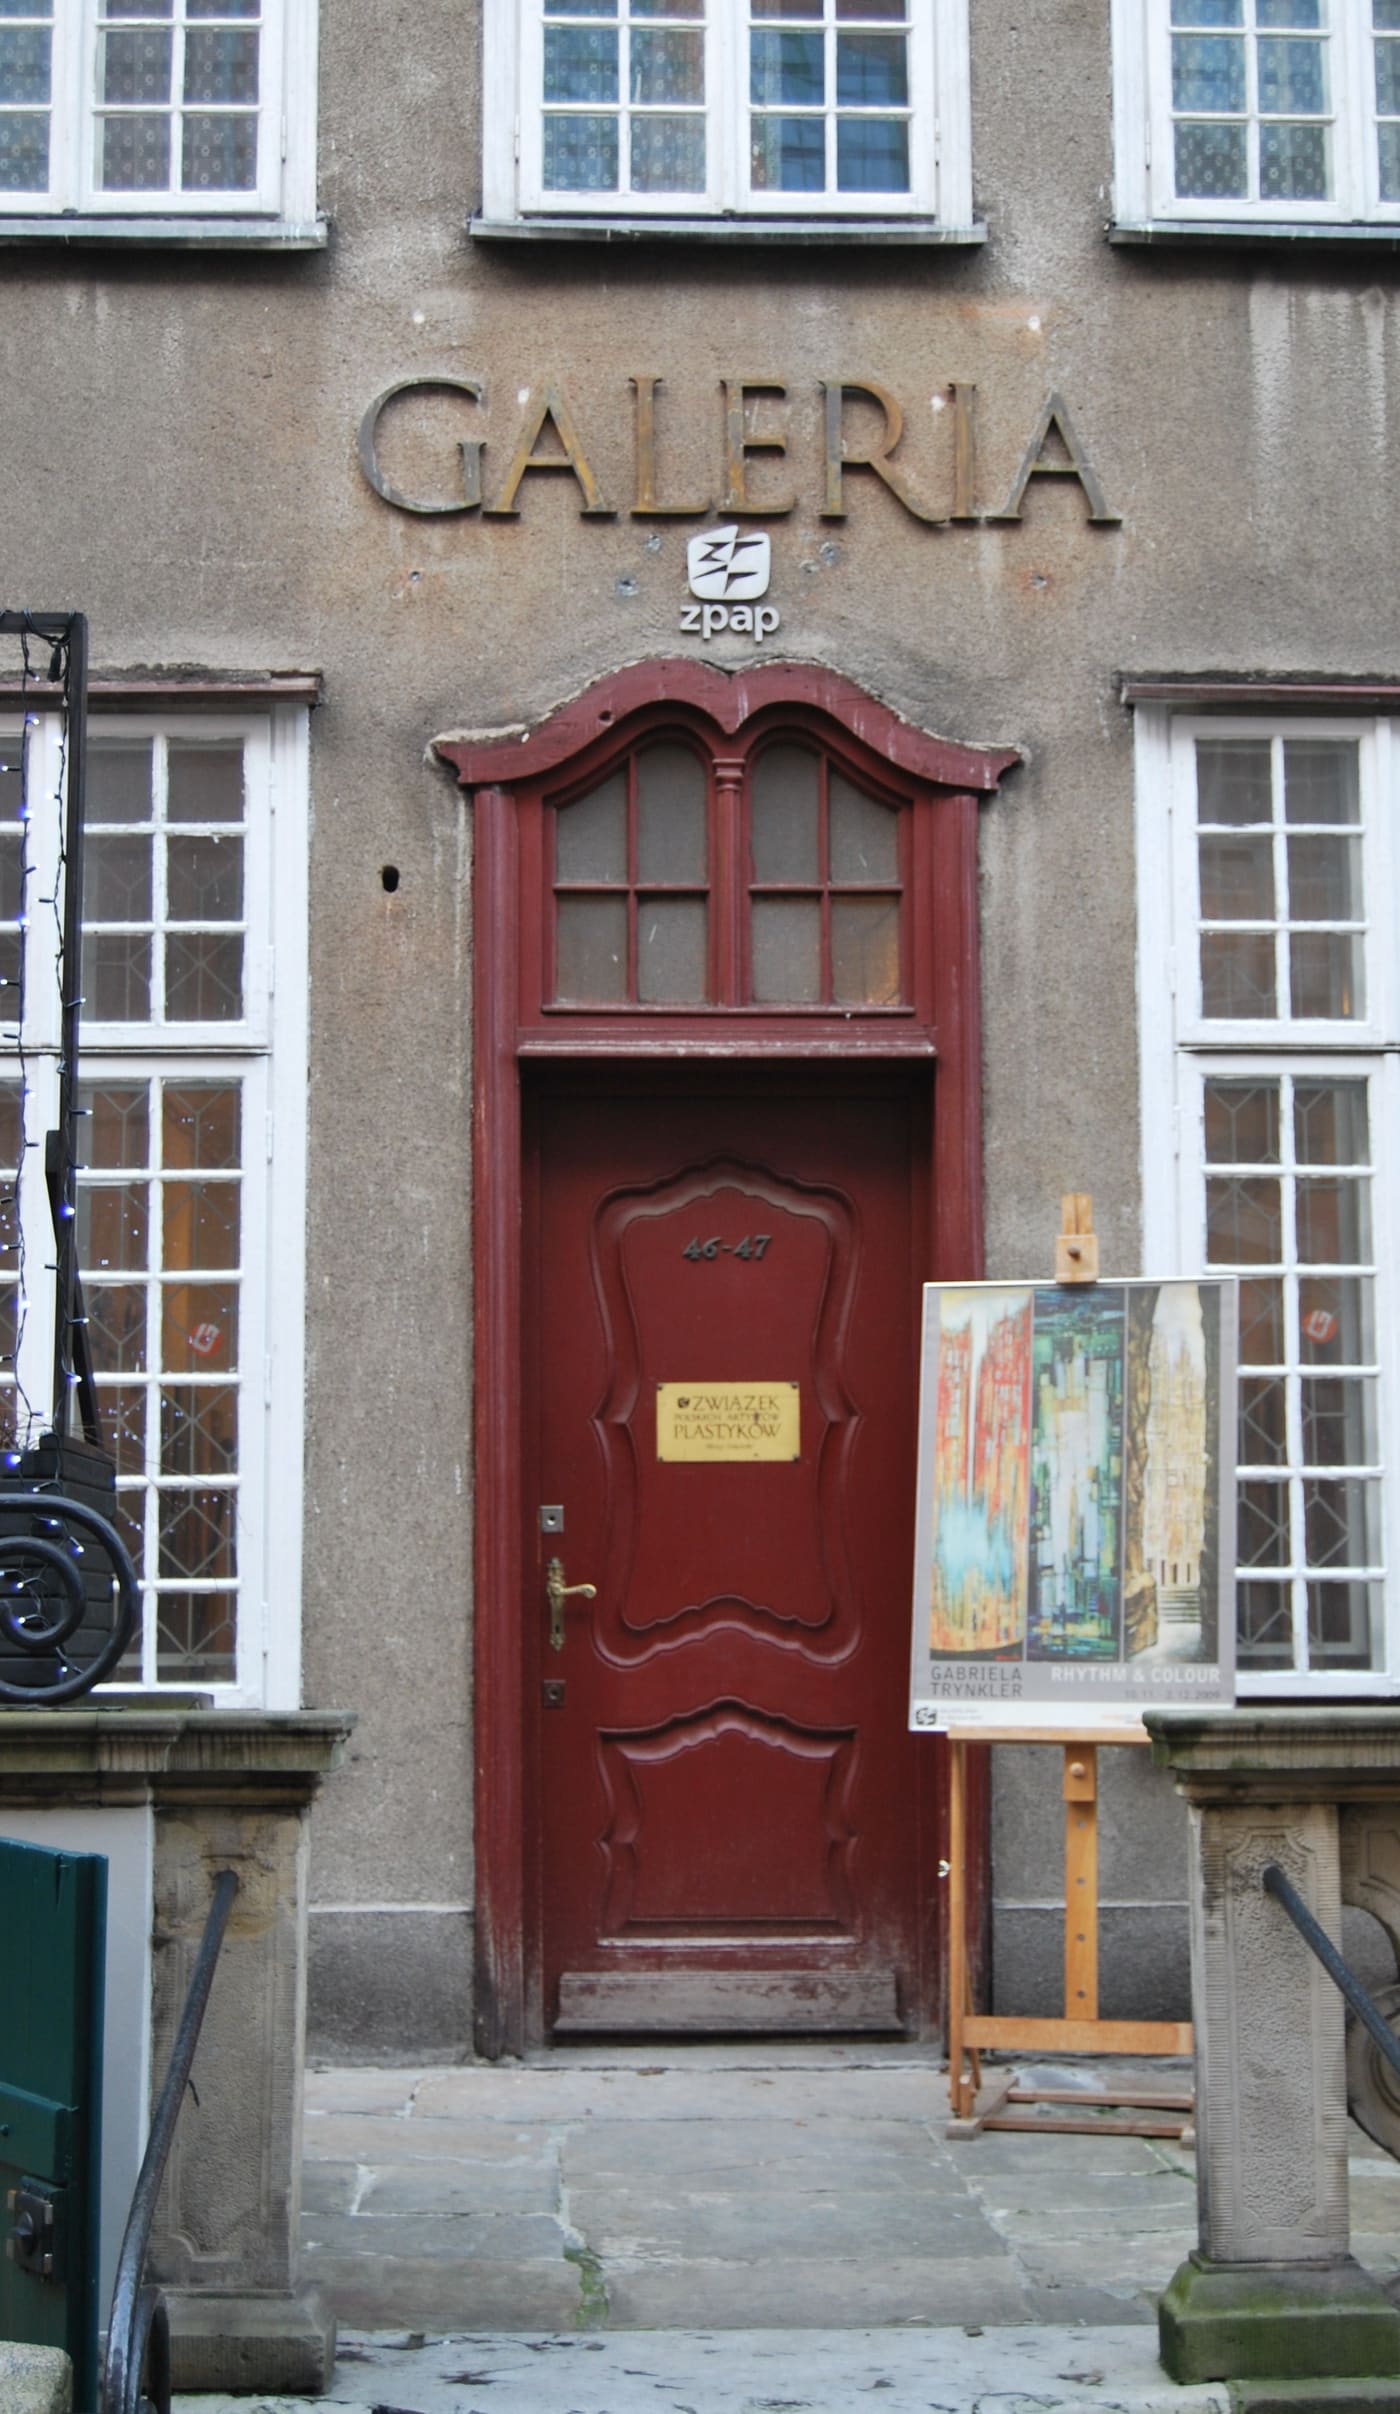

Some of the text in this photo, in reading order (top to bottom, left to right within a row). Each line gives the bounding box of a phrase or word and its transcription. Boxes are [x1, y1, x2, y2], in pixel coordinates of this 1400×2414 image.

[357, 376, 1123, 525] GALERIA
[680, 604, 780, 643] zpap
[682, 1235, 773, 1261] 46-47
[930, 1666, 1023, 1682] GABRIELA
[1051, 1666, 1221, 1684] RHYTHM & COLOUR
[930, 1683, 1023, 1698] TRYNKLER
